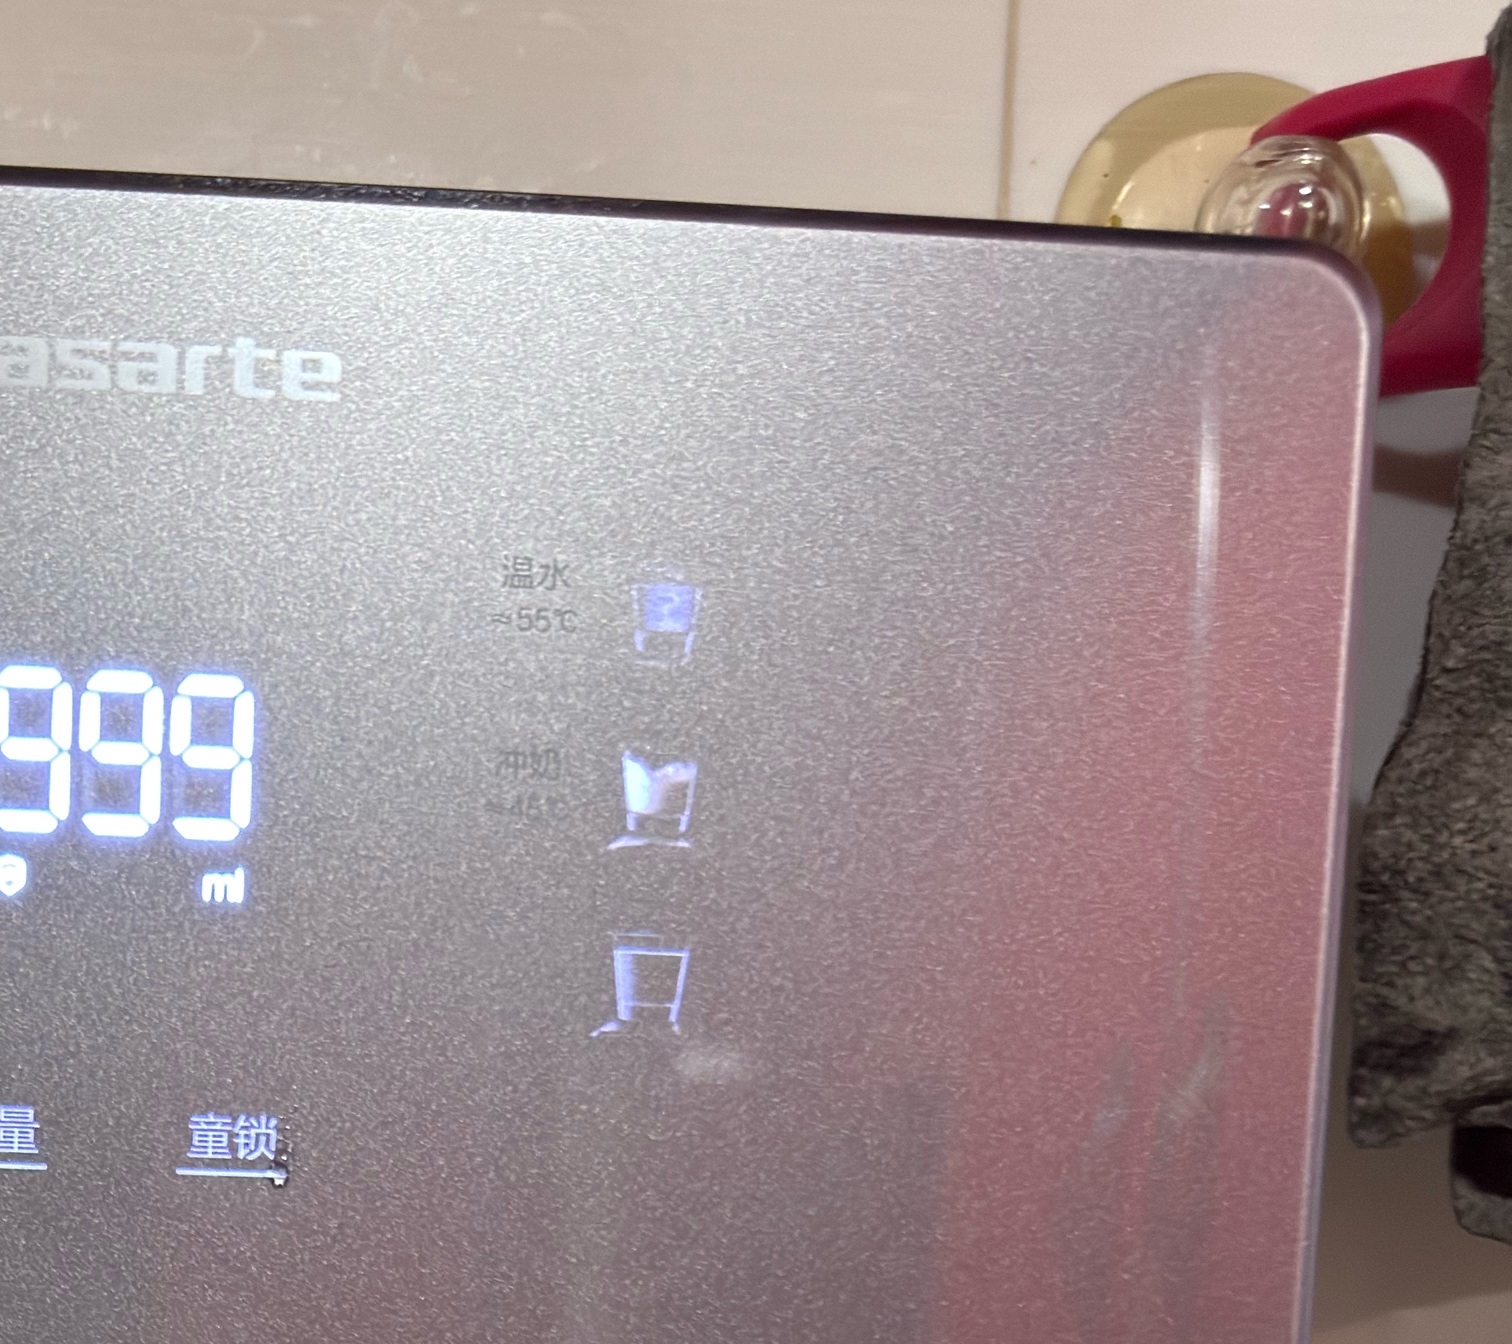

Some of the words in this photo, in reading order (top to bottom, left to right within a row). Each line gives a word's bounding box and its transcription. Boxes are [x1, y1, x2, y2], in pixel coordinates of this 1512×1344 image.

[502, 554, 571, 591] 温水
[201, 865, 245, 904] ml
[186, 1110, 280, 1161] 童锁
